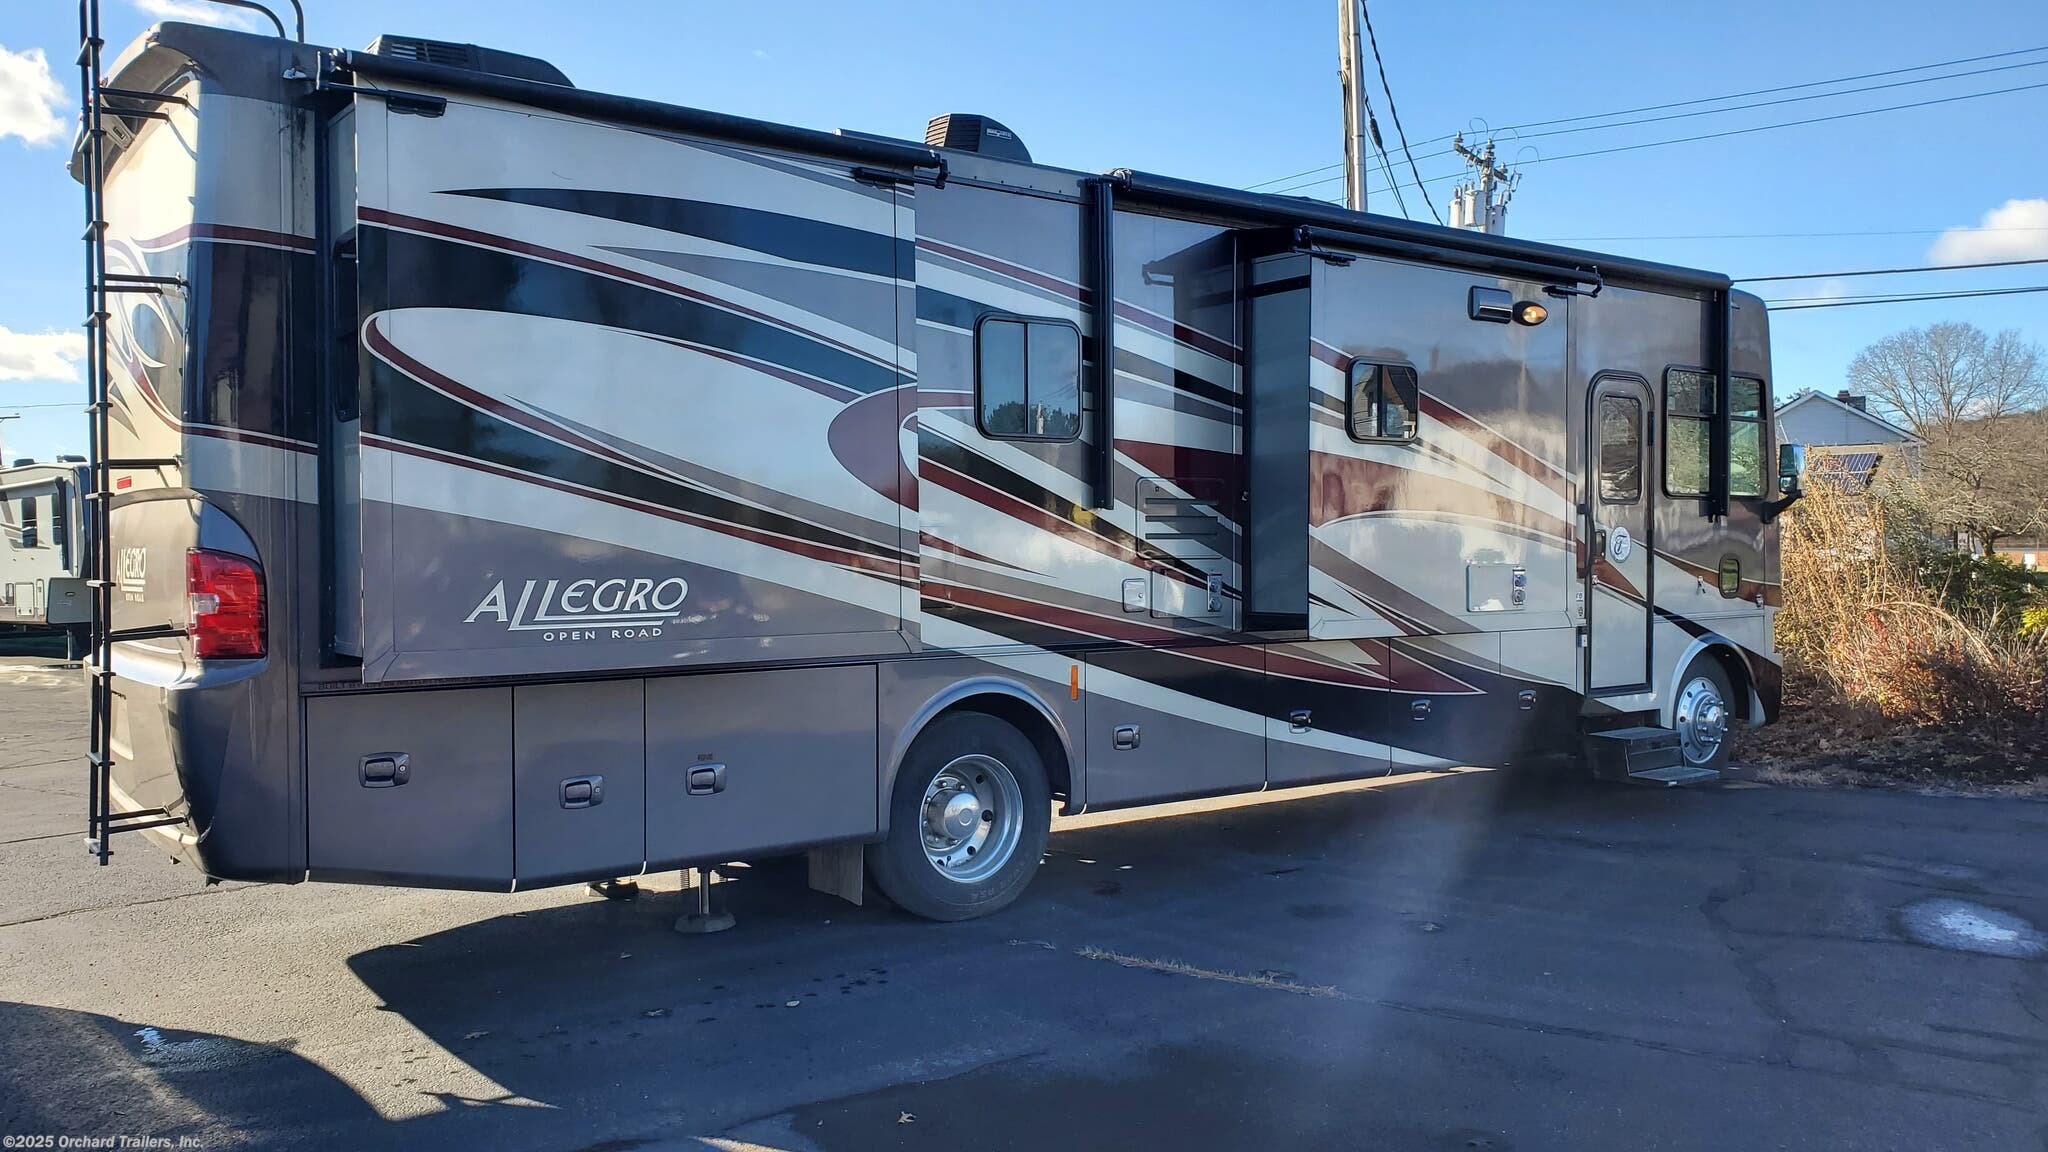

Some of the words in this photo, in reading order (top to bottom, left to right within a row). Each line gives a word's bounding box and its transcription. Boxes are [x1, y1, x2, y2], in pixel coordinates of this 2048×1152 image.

[115, 548, 147, 592] ALLEGRO
[463, 577, 689, 631] ALLEGRO
[543, 631, 596, 641] OPEN
[611, 628, 663, 639] ROAD
